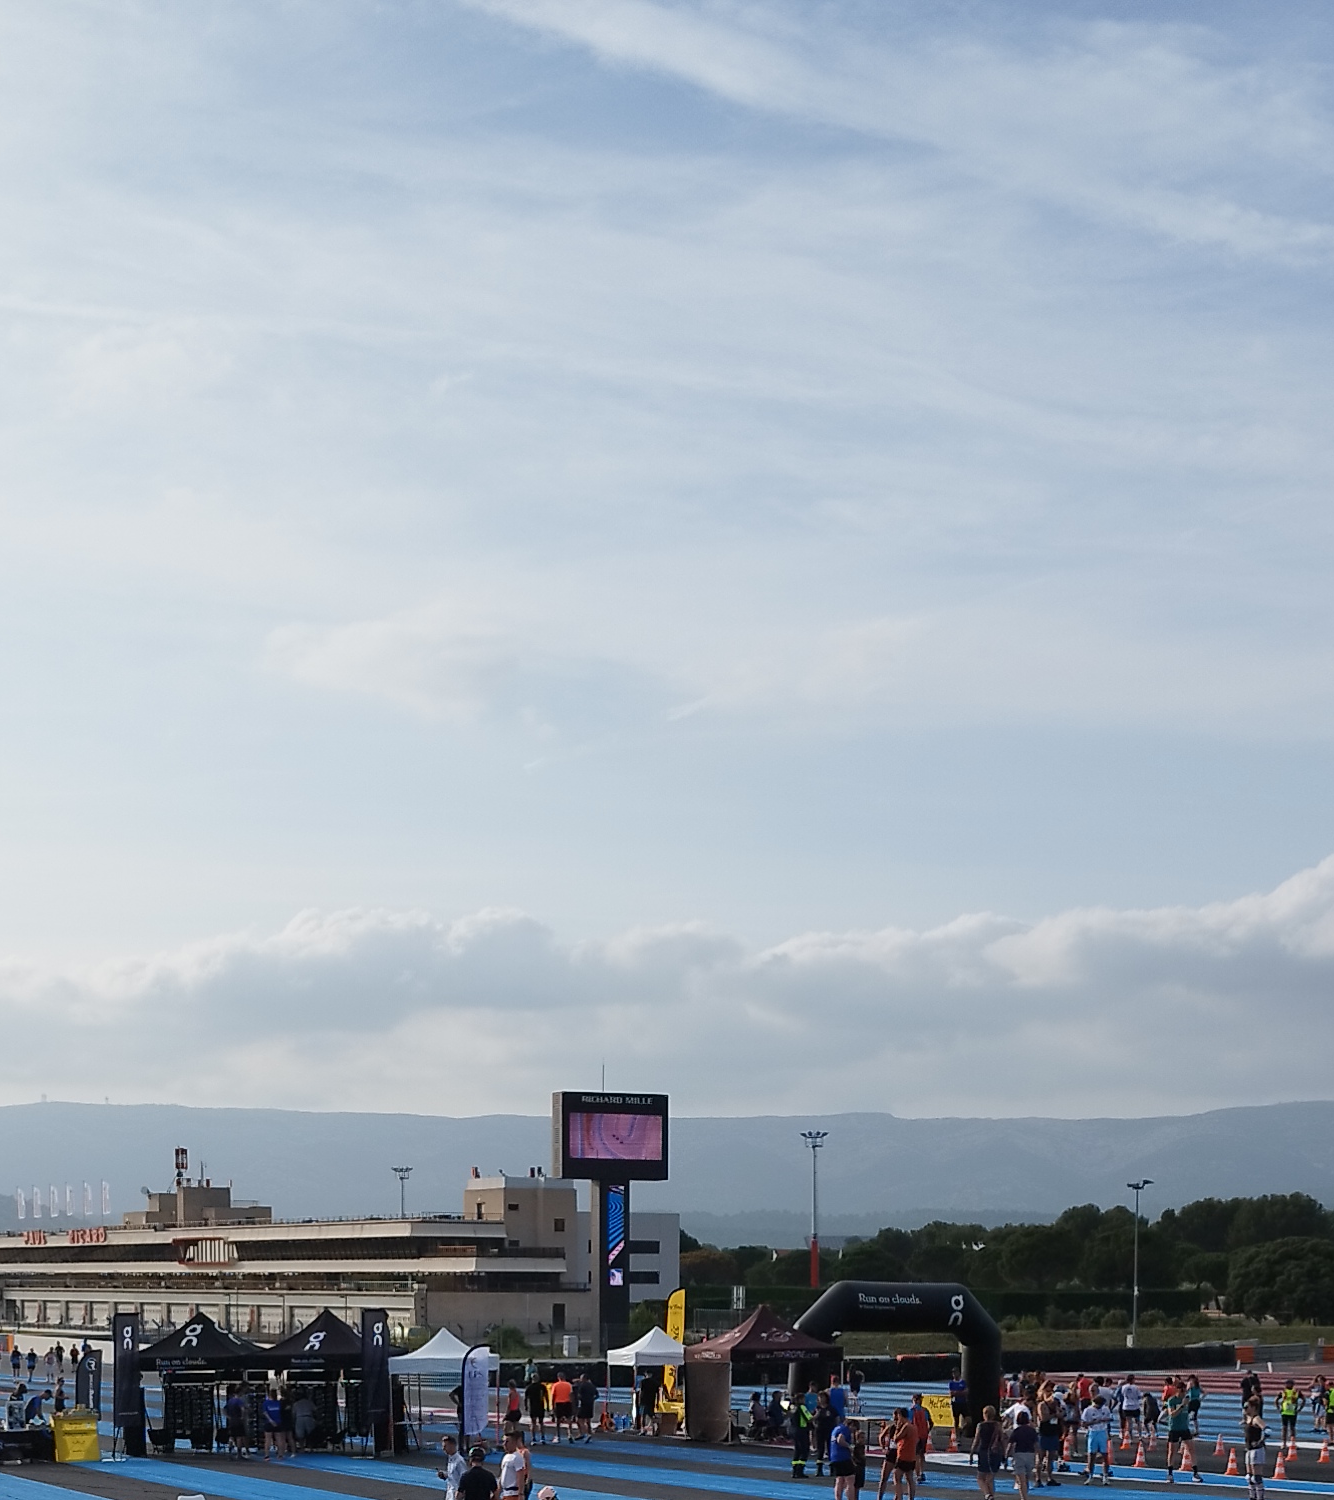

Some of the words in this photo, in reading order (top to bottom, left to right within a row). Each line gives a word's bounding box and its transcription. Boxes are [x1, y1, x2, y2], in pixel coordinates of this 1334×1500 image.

[581, 1095, 623, 1104] RICHARD
[625, 1096, 654, 1105] MILLE
[858, 1292, 877, 1303] Run
[891, 1293, 923, 1304] clouds.
[156, 1358, 170, 1366] Run
